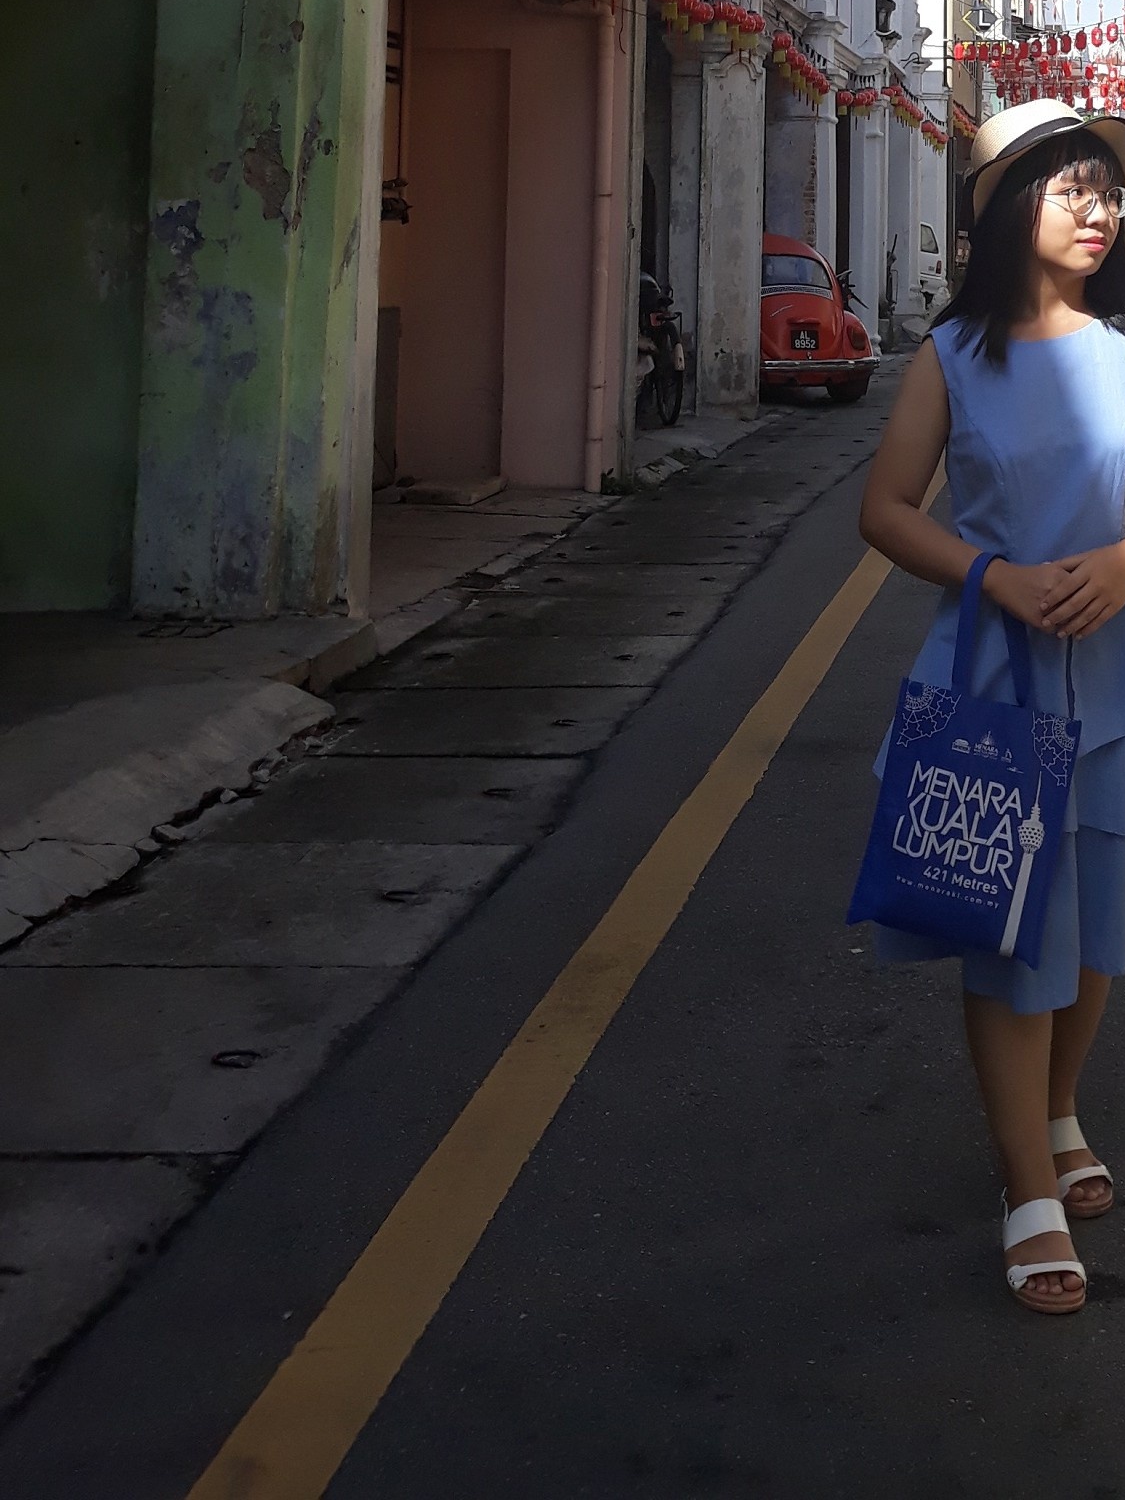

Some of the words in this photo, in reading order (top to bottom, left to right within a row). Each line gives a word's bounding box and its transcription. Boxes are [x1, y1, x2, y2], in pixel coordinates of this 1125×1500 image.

[794, 339, 816, 349] 8952
[800, 330, 811, 340] AL
[907, 760, 1023, 818] MENARA
[908, 792, 1014, 851] KUALA
[892, 814, 1014, 890] LUMPUR
[923, 865, 948, 882] 421
[951, 873, 999, 895] Metres
